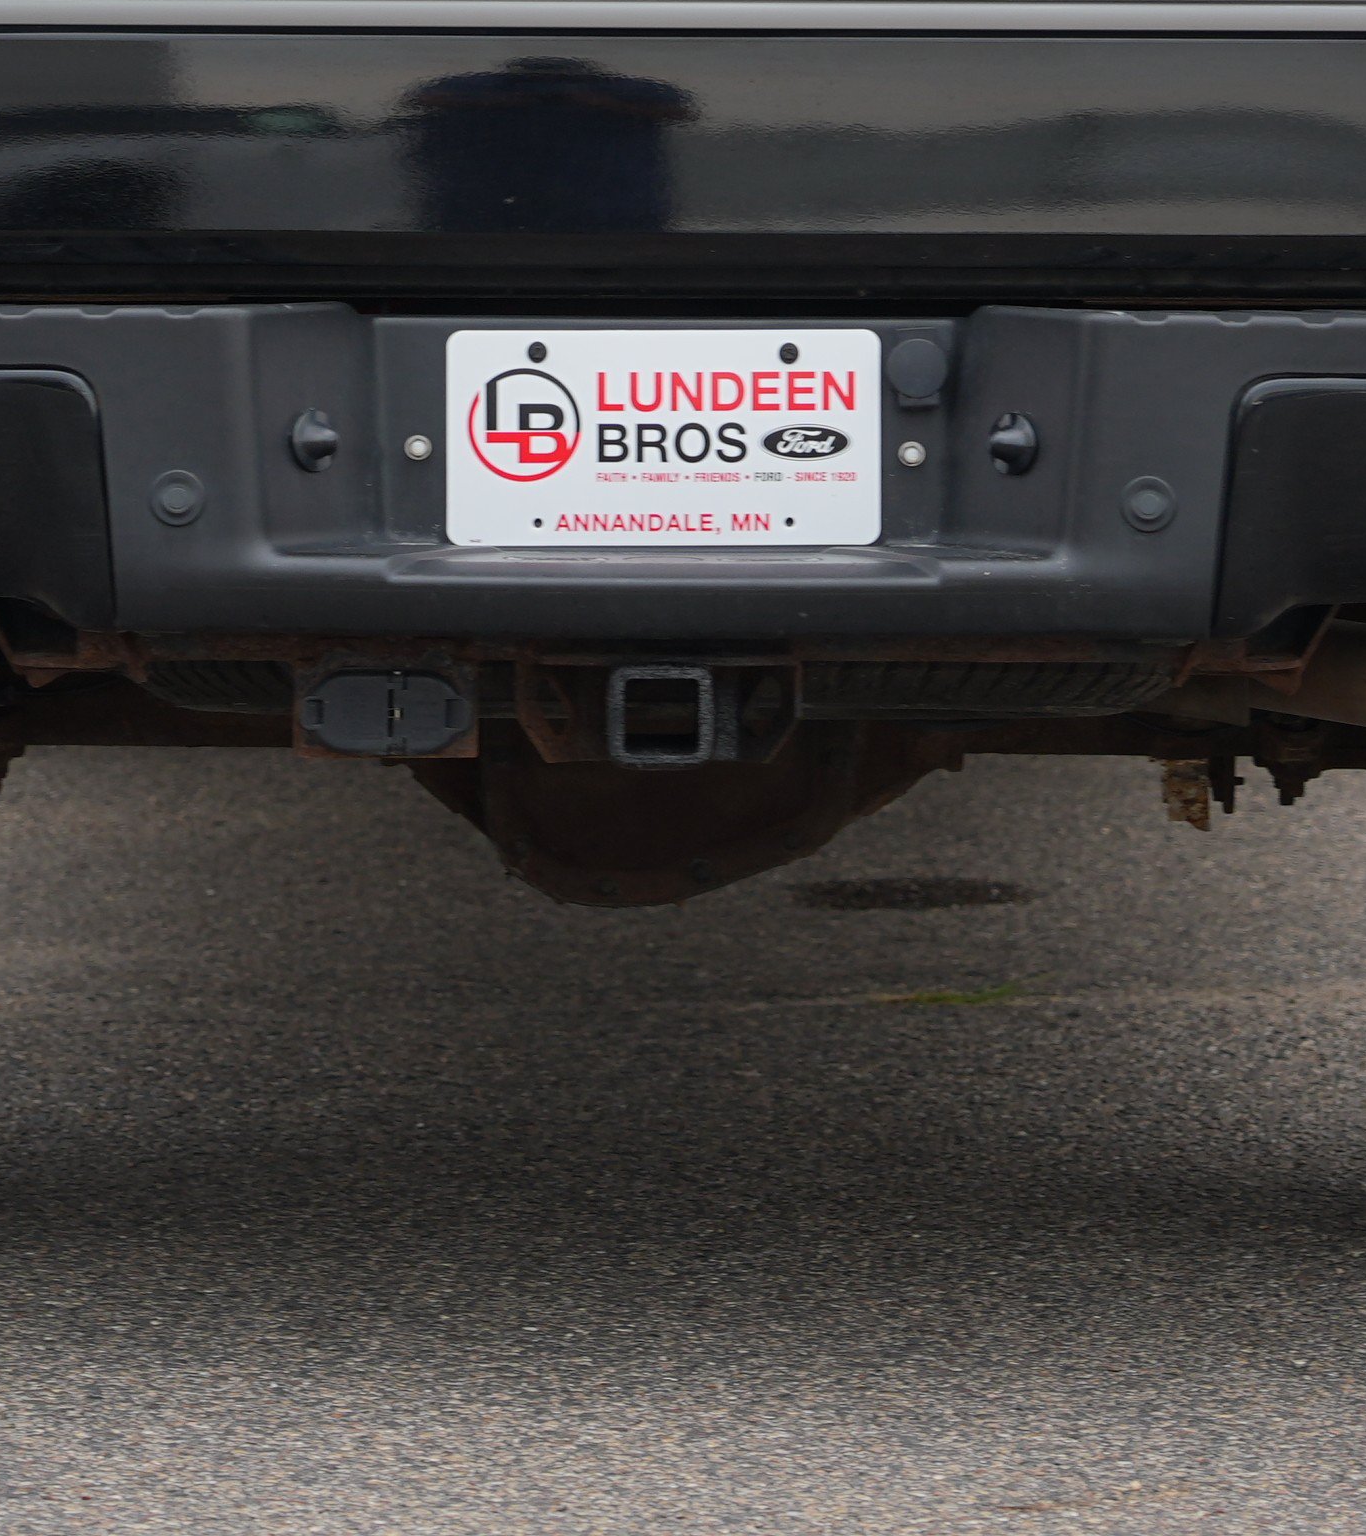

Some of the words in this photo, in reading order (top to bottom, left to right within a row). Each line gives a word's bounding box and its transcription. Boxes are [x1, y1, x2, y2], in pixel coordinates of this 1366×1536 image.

[597, 370, 857, 413] LUNDEEN
[597, 421, 748, 464] BROS
[776, 428, 837, 454] Ford
[554, 512, 722, 535] ANNANDALE,
[730, 512, 772, 533] MN
